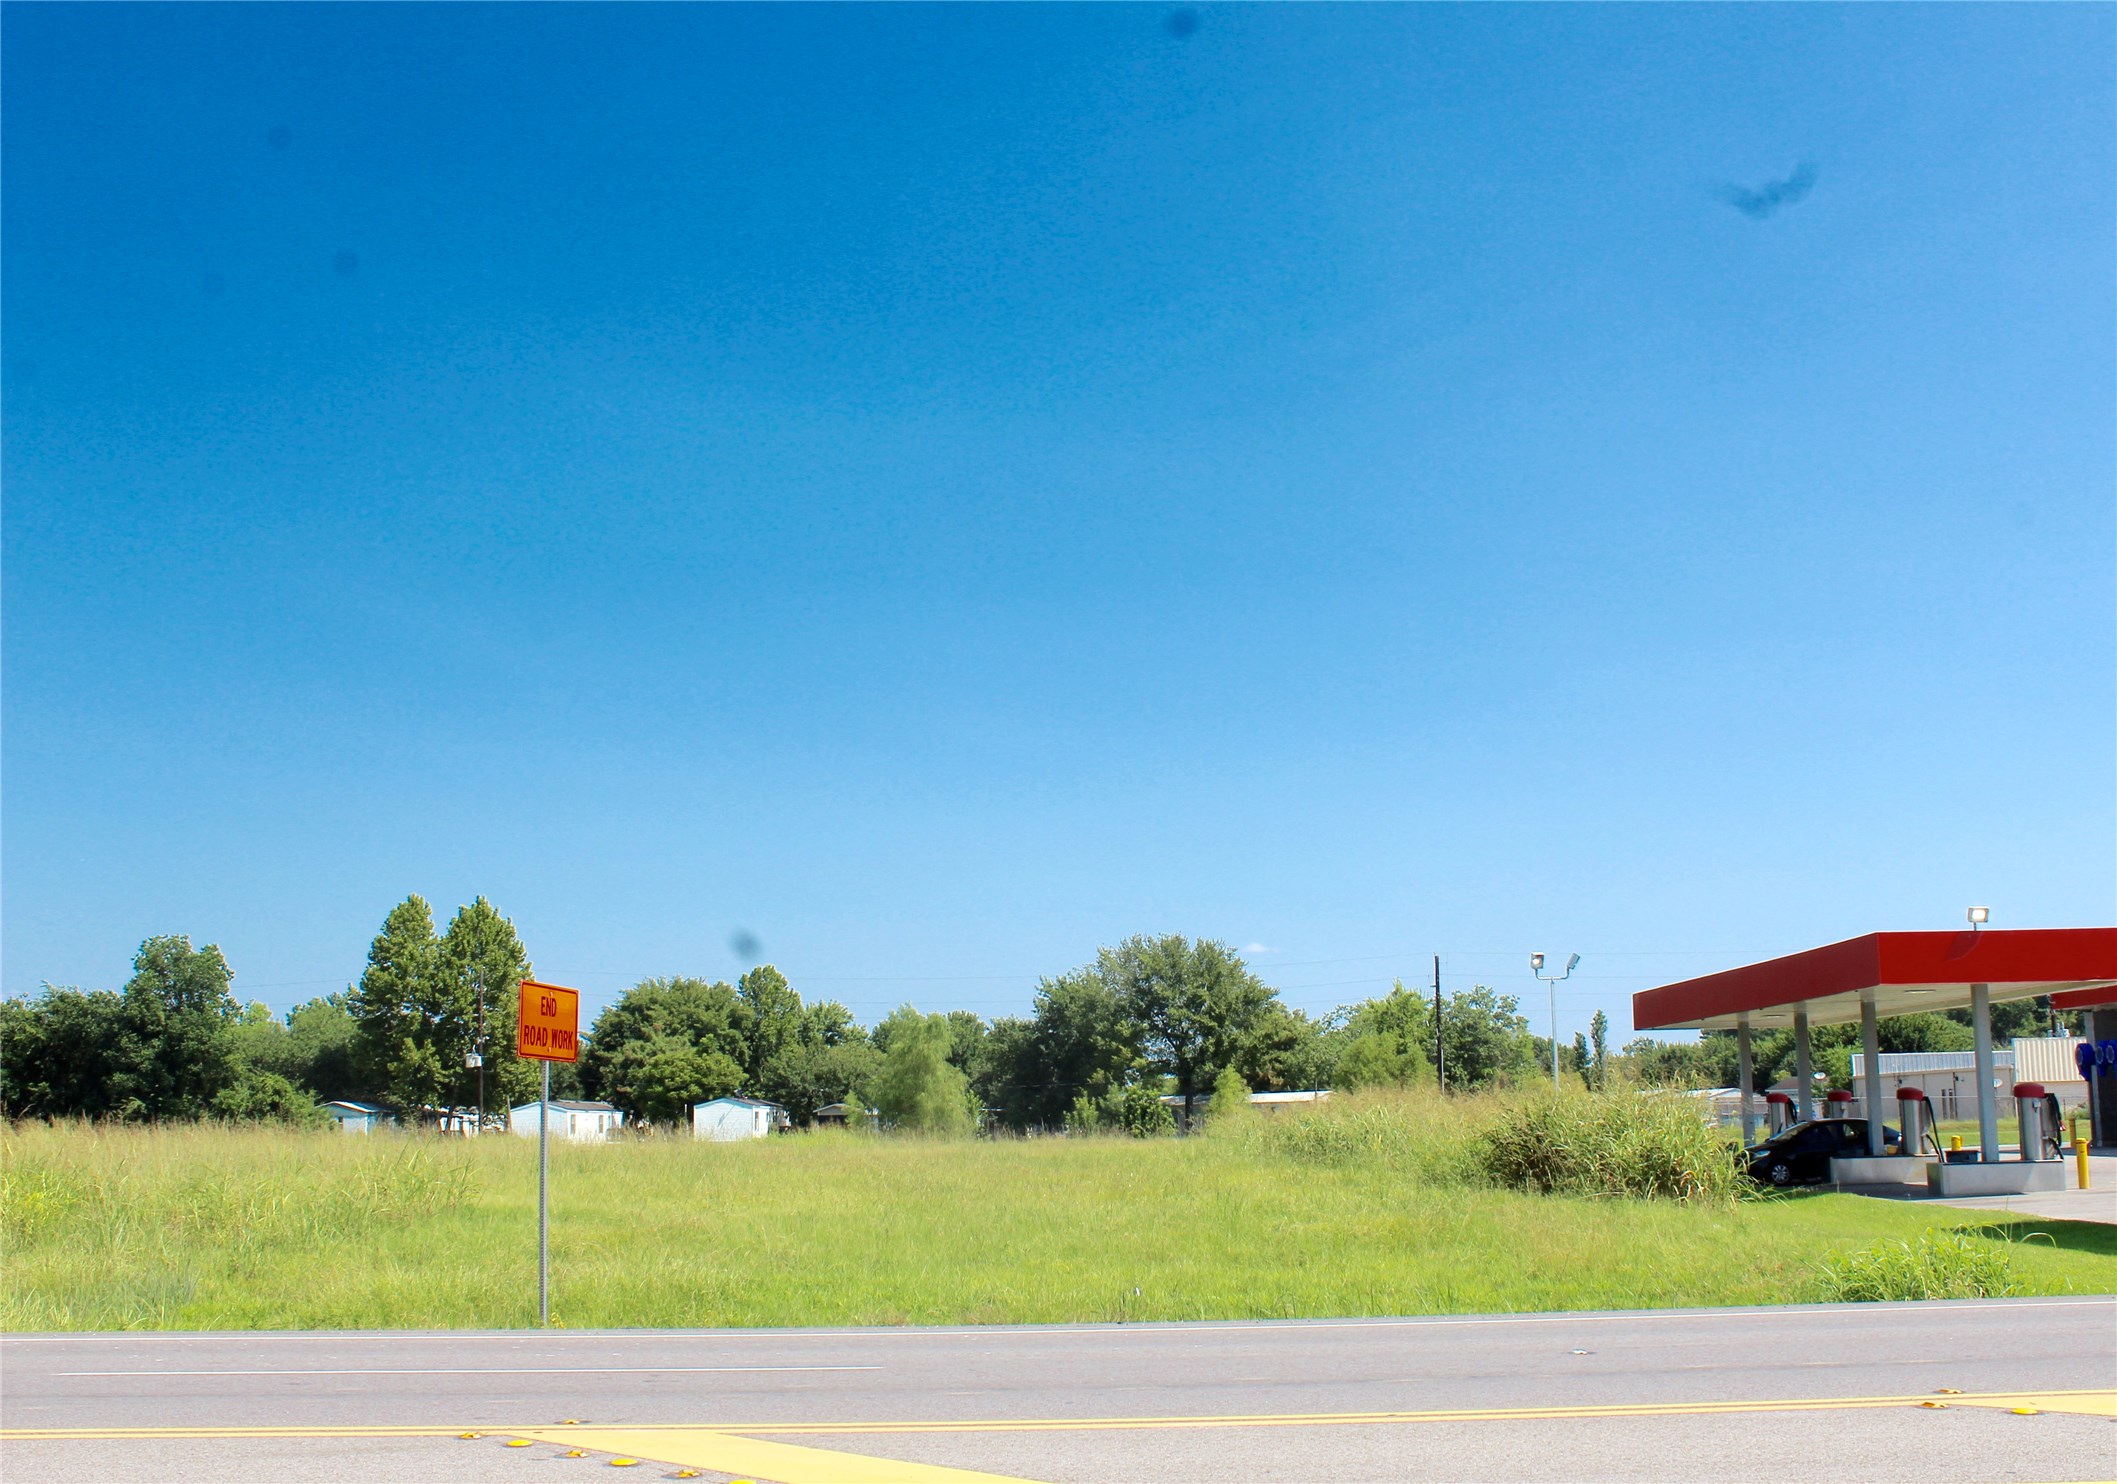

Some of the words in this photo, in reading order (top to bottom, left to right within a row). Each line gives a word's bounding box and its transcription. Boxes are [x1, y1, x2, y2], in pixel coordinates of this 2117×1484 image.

[541, 996, 557, 1017] END
[523, 1025, 548, 1047] ROAD
[551, 1028, 573, 1050] WORK
